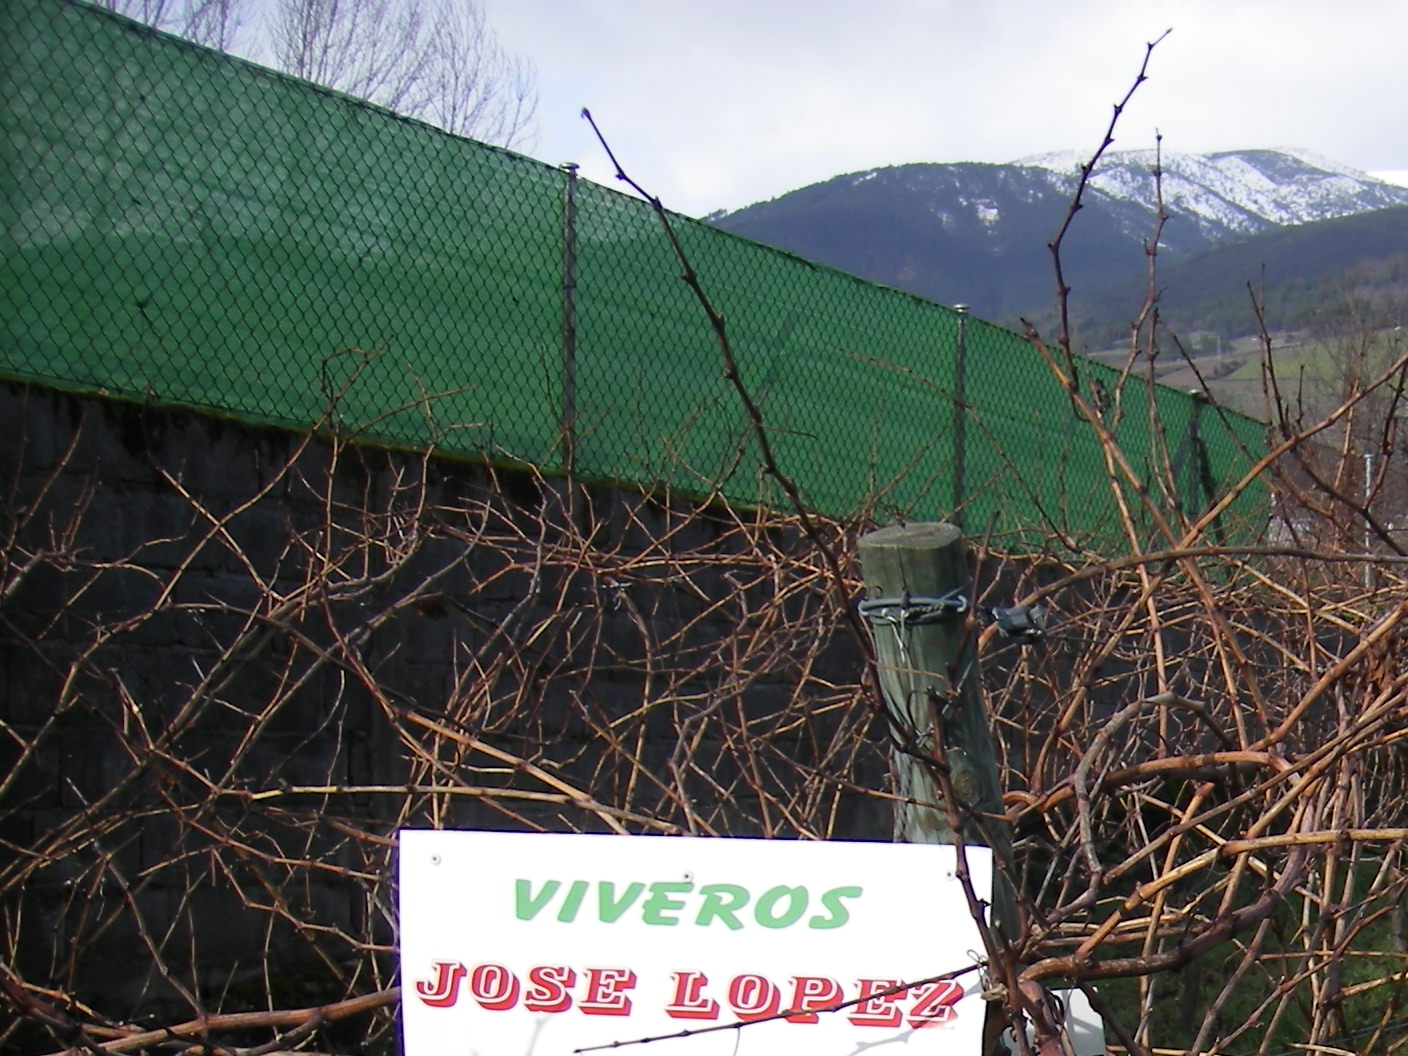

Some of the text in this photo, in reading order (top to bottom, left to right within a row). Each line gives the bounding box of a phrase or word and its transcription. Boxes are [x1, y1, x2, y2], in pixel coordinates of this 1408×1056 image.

[516, 880, 862, 930] VIVEROS
[415, 961, 965, 1030] JOSE LOPEZ
